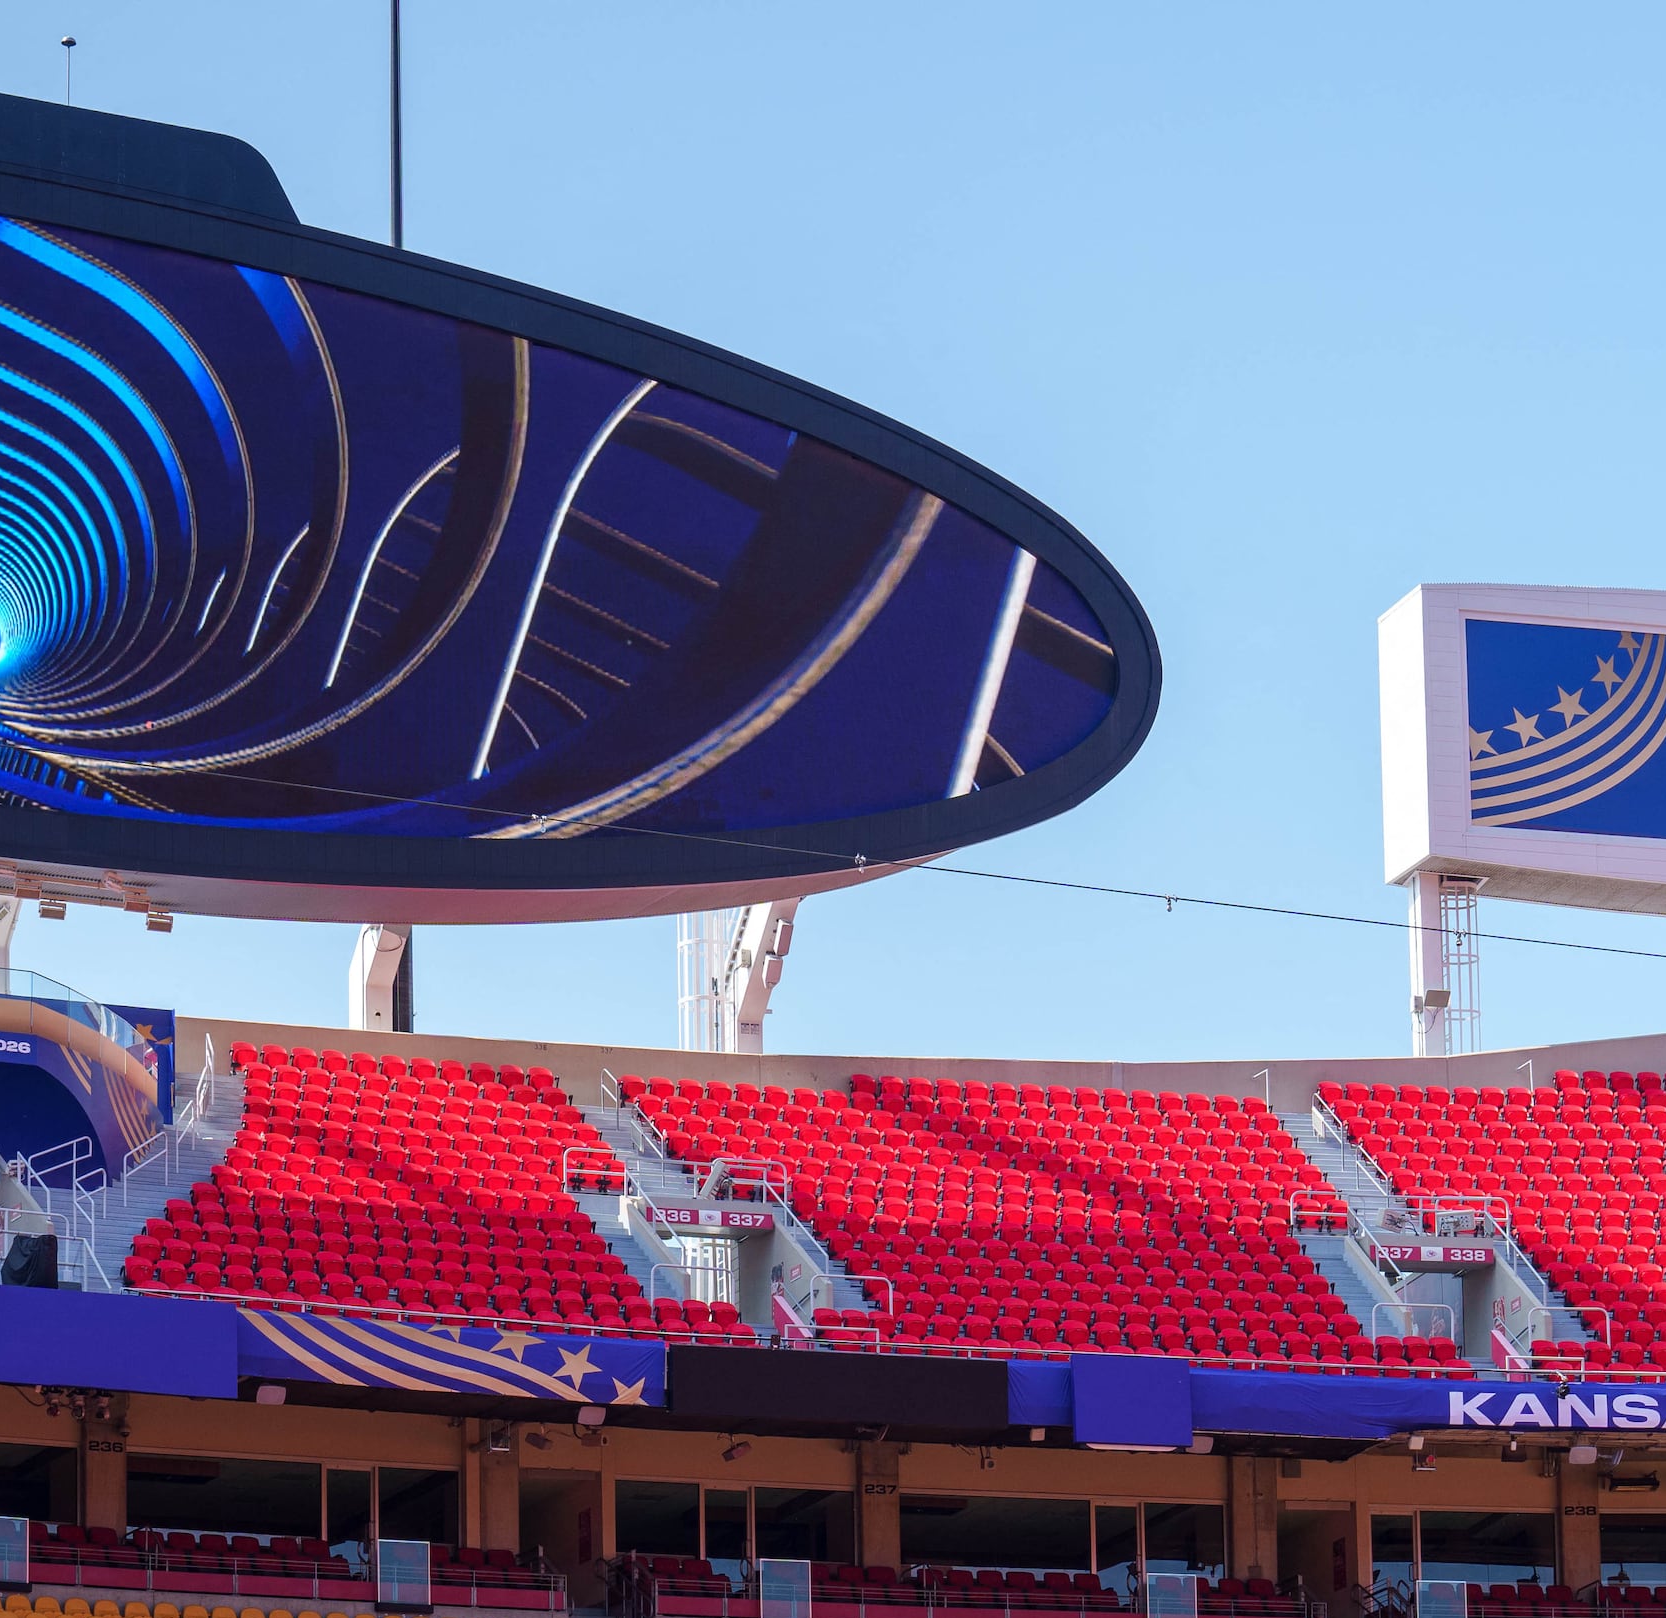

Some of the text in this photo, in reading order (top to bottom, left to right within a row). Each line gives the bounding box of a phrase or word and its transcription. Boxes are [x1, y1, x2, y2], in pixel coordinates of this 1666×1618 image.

[655, 1208, 691, 1223] 336
[728, 1213, 765, 1227] 337
[1377, 1246, 1413, 1260] 337
[1450, 1248, 1486, 1263] 338
[88, 1440, 124, 1453] 236
[864, 1483, 898, 1495] 237
[1564, 1505, 1597, 1516] 238
